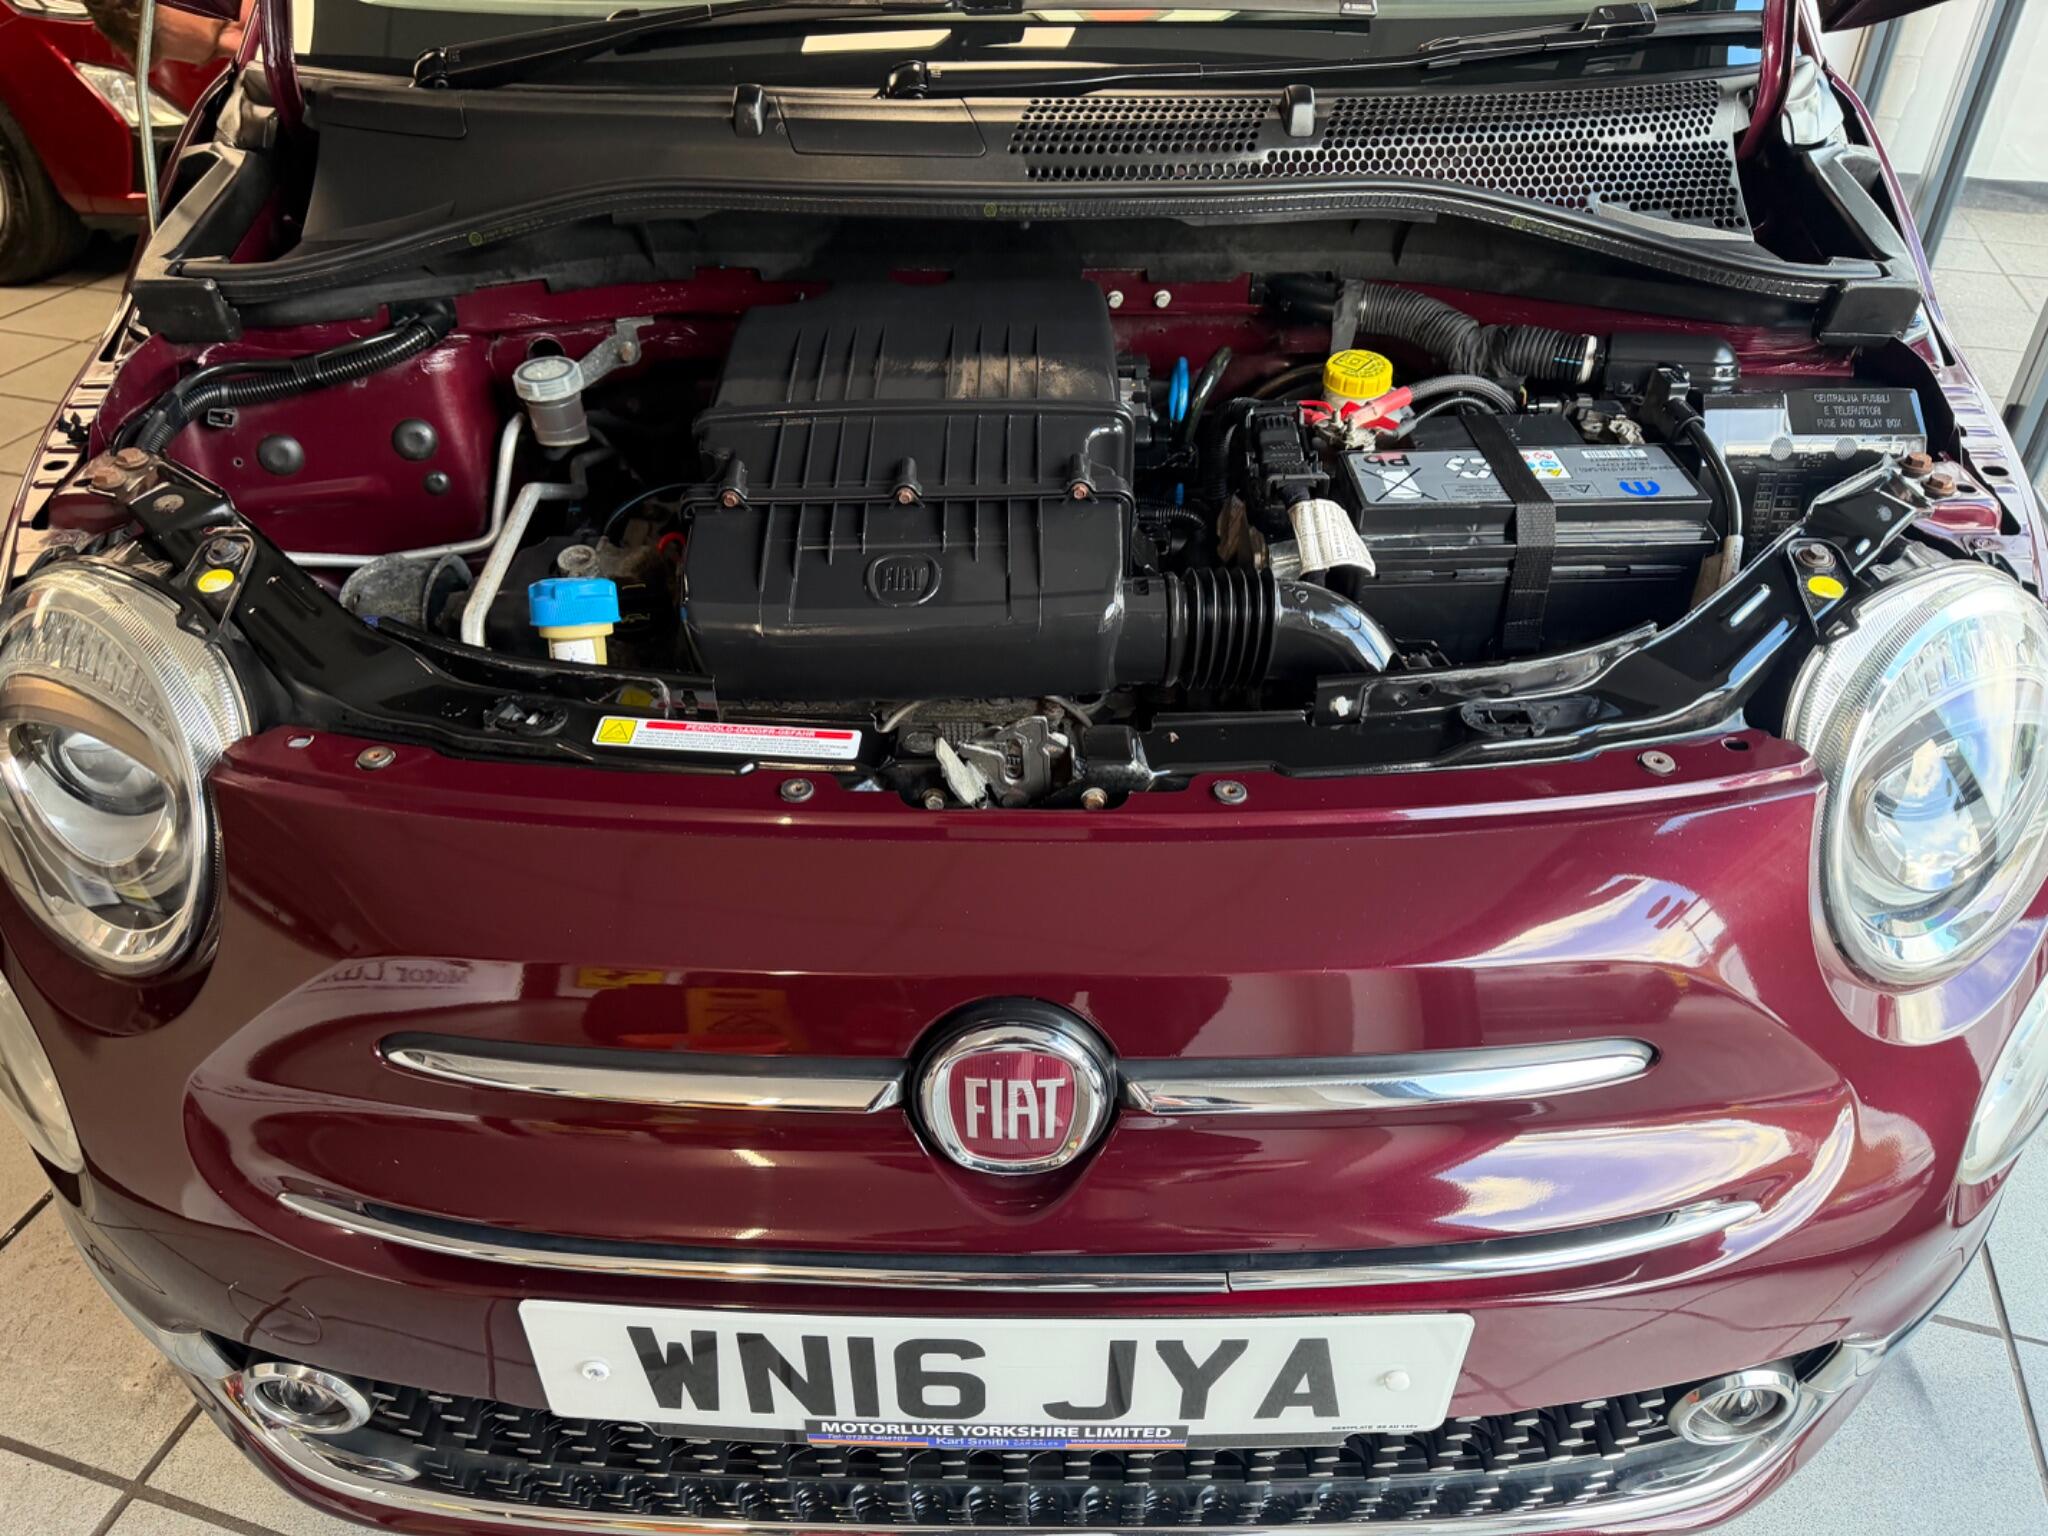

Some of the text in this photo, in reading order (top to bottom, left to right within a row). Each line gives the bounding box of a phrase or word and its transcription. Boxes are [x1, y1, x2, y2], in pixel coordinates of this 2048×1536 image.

[1824, 406, 1830, 416] E
[1840, 418, 1855, 428] AND
[1859, 418, 1882, 428] RELAY
[1363, 453, 1411, 467] Pb
[881, 565, 927, 592] FIAT
[964, 1076, 1066, 1140] FIAT
[626, 1325, 1341, 1420] WN16 JYA
[821, 1422, 1172, 1438] MOTORLUXE YORKSHIRE LIMITED
[936, 1437, 1009, 1447] Karl Smith
